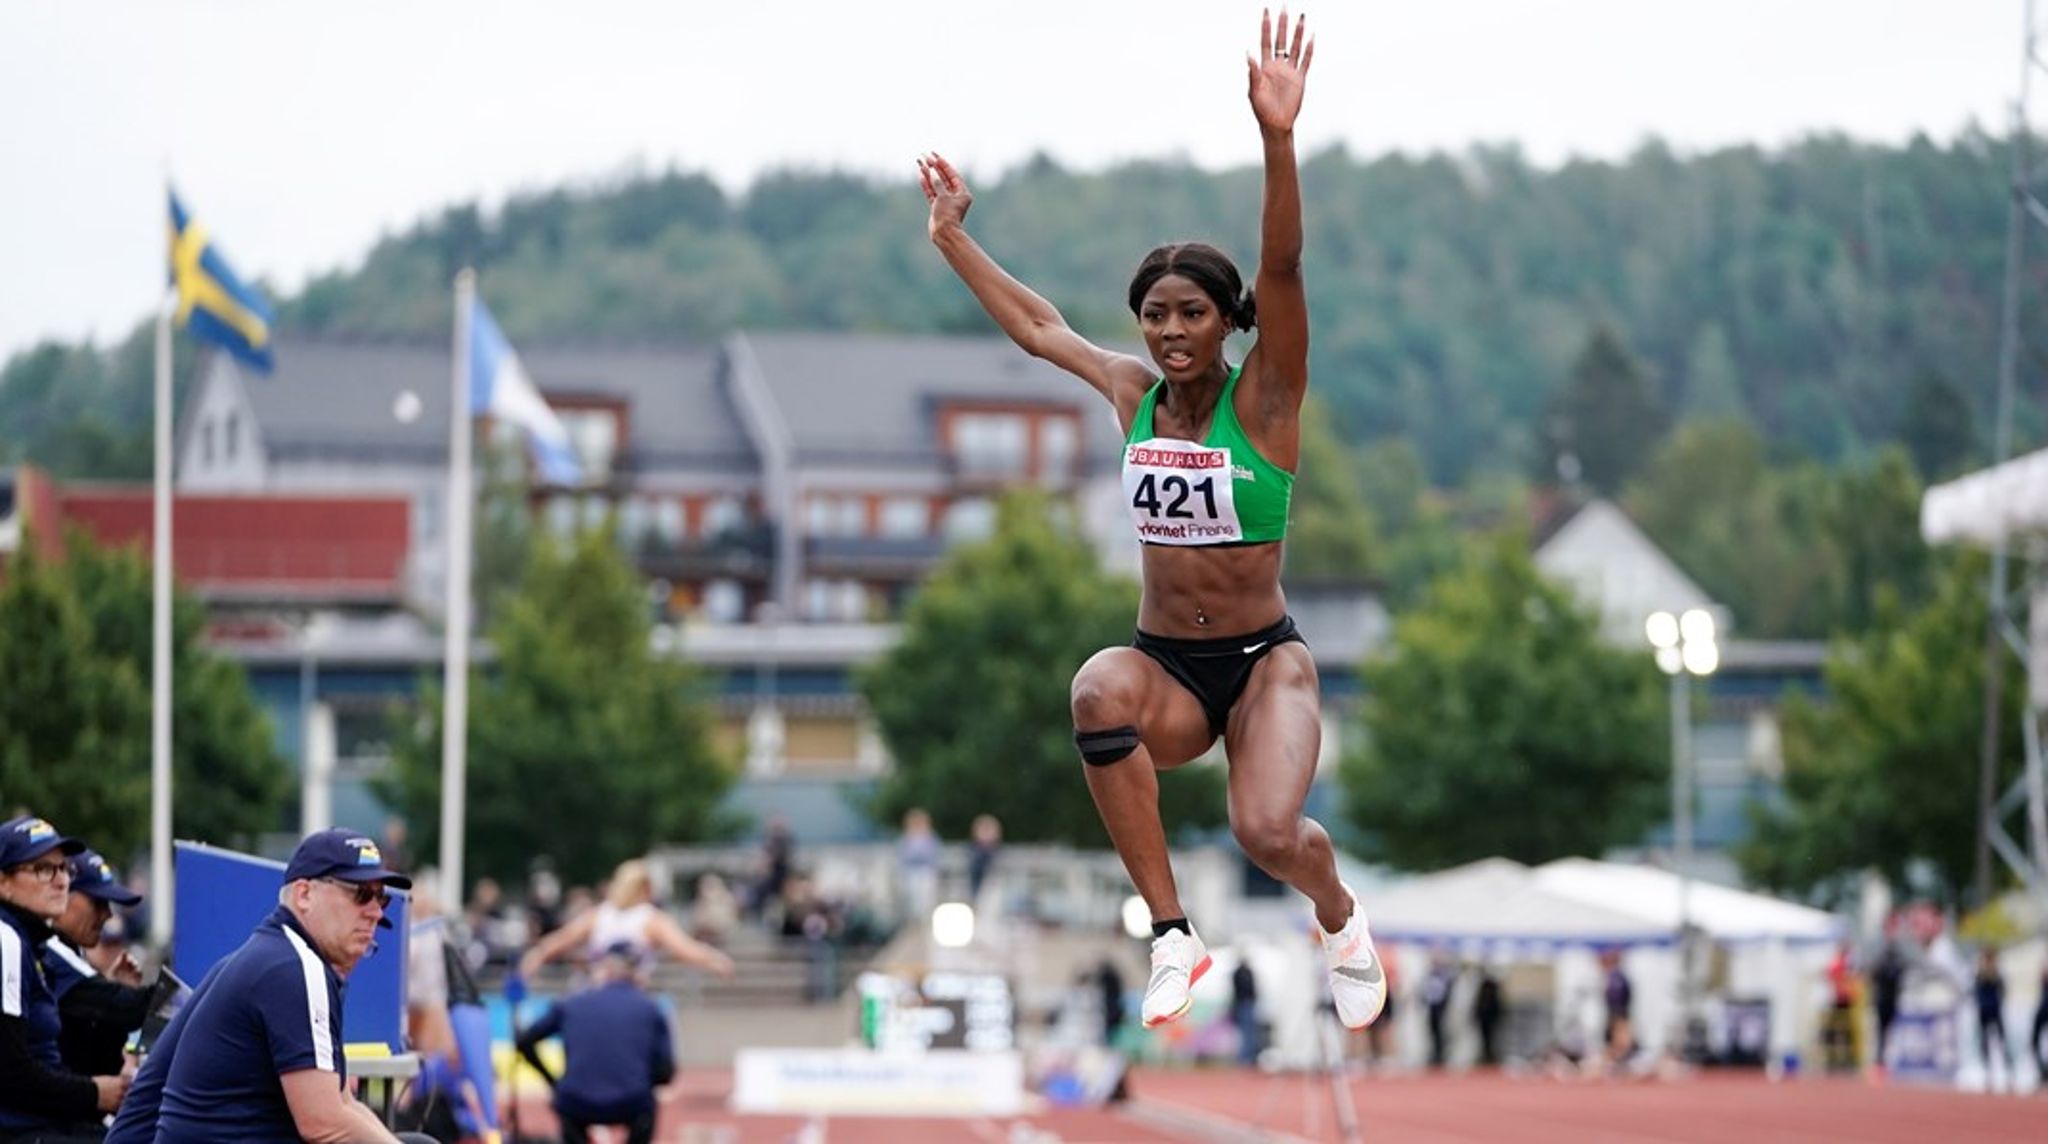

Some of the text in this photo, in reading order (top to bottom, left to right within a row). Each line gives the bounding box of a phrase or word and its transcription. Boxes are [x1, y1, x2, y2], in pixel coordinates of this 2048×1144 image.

[1137, 450, 1222, 467] BAUHAUS
[1132, 474, 1218, 519] 421
[1137, 522, 1186, 538] rioritet
